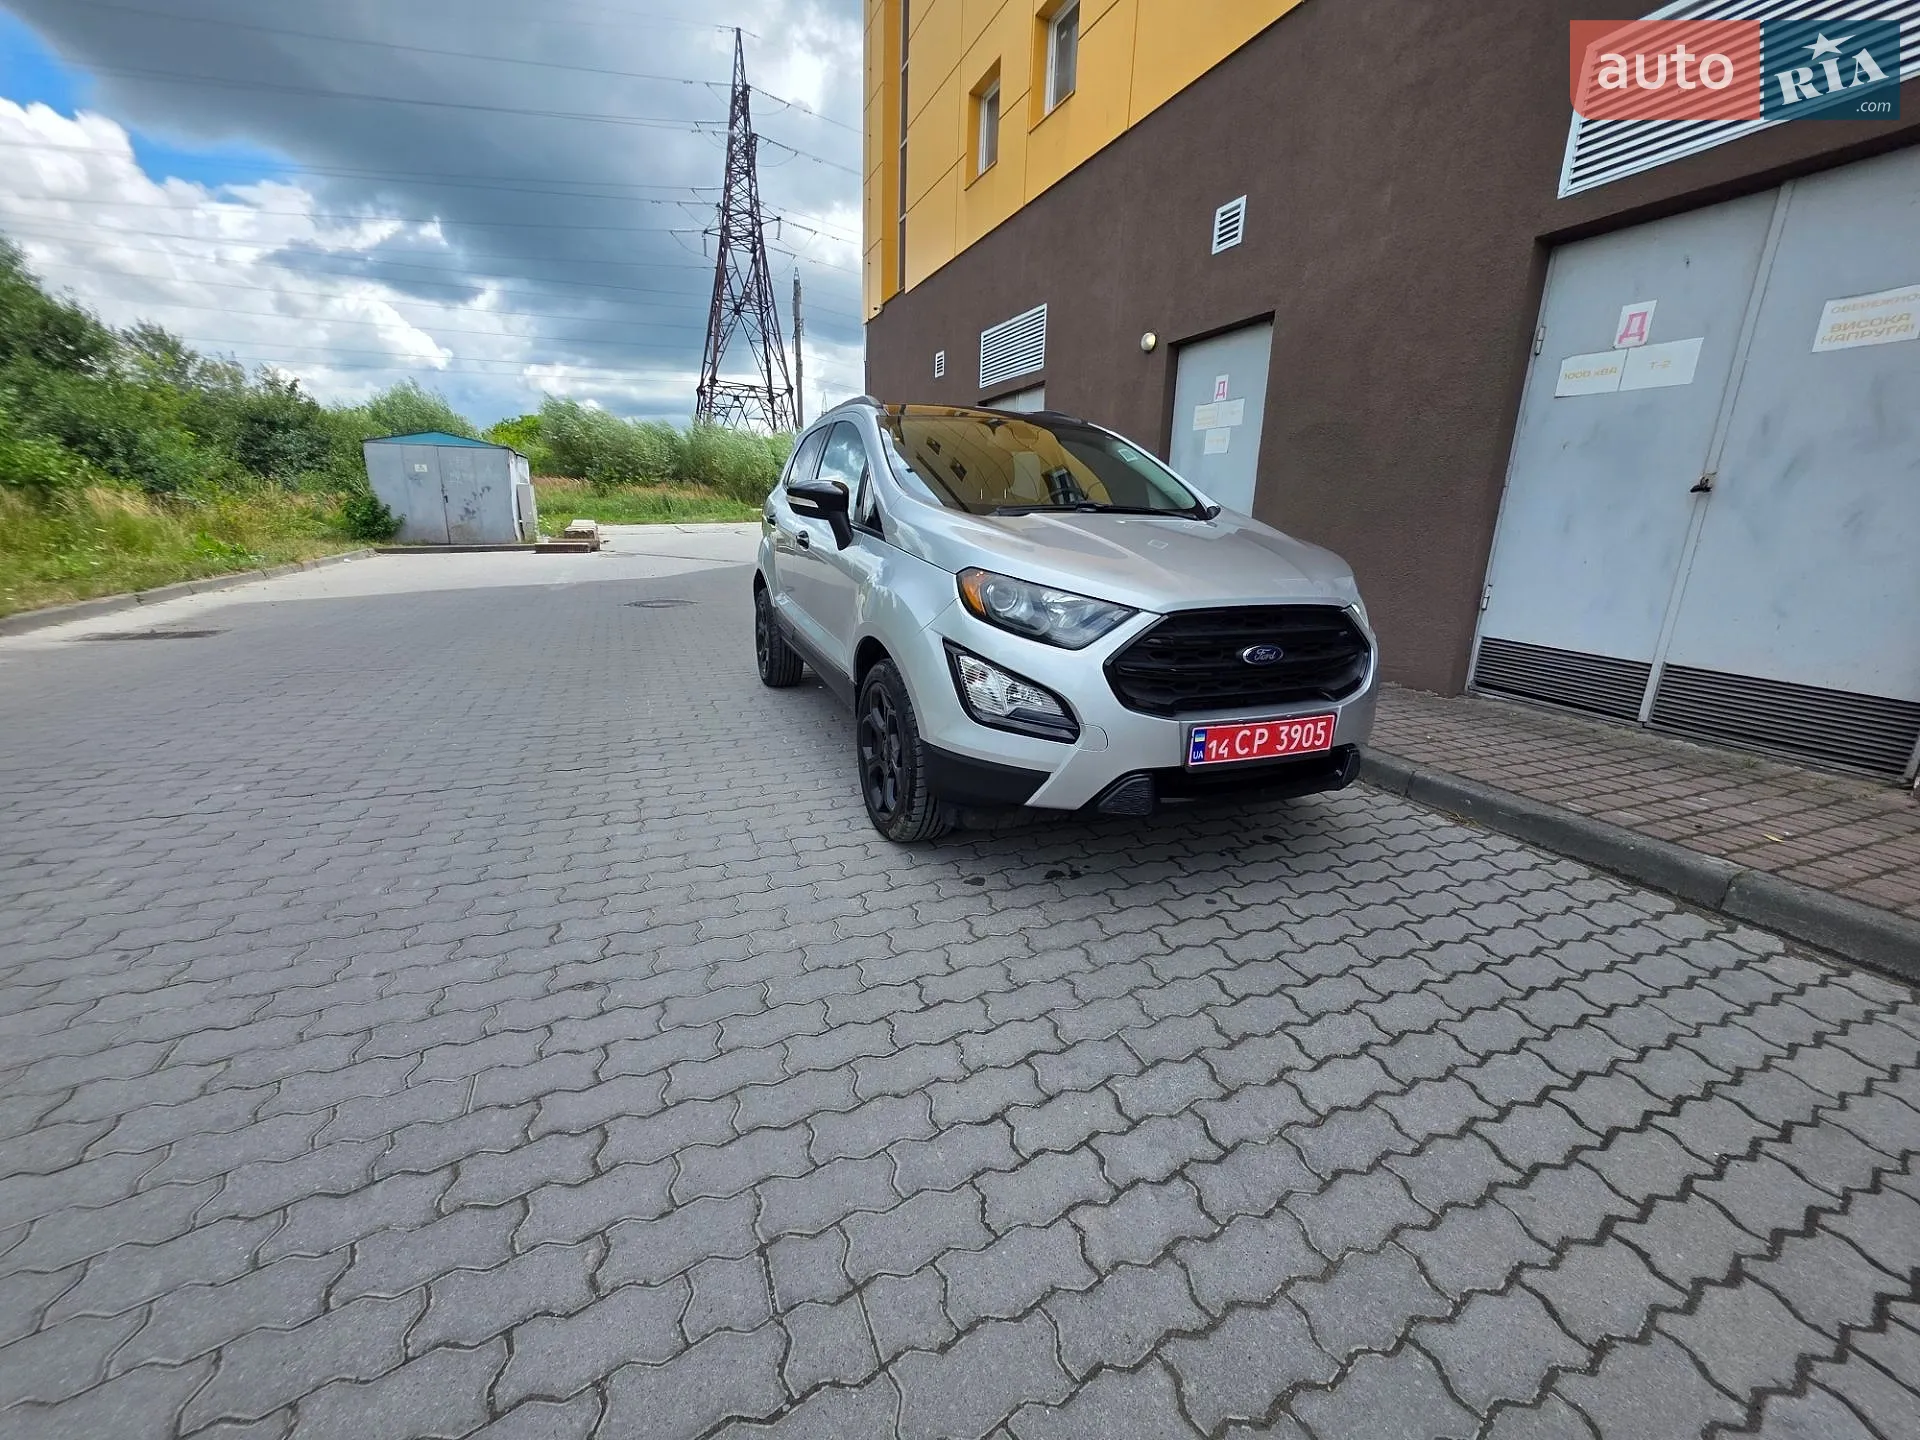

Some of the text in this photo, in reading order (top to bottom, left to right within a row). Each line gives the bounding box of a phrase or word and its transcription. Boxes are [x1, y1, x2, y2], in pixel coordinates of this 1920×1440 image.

[1617, 311, 1648, 345] Д
[1830, 312, 1912, 333] ВИСОКА
[1215, 381, 1226, 399] Д
[1254, 648, 1277, 662] Ford
[1208, 739, 1229, 759] 14
[1276, 721, 1327, 751] 3905
[1192, 750, 1204, 760] UA
